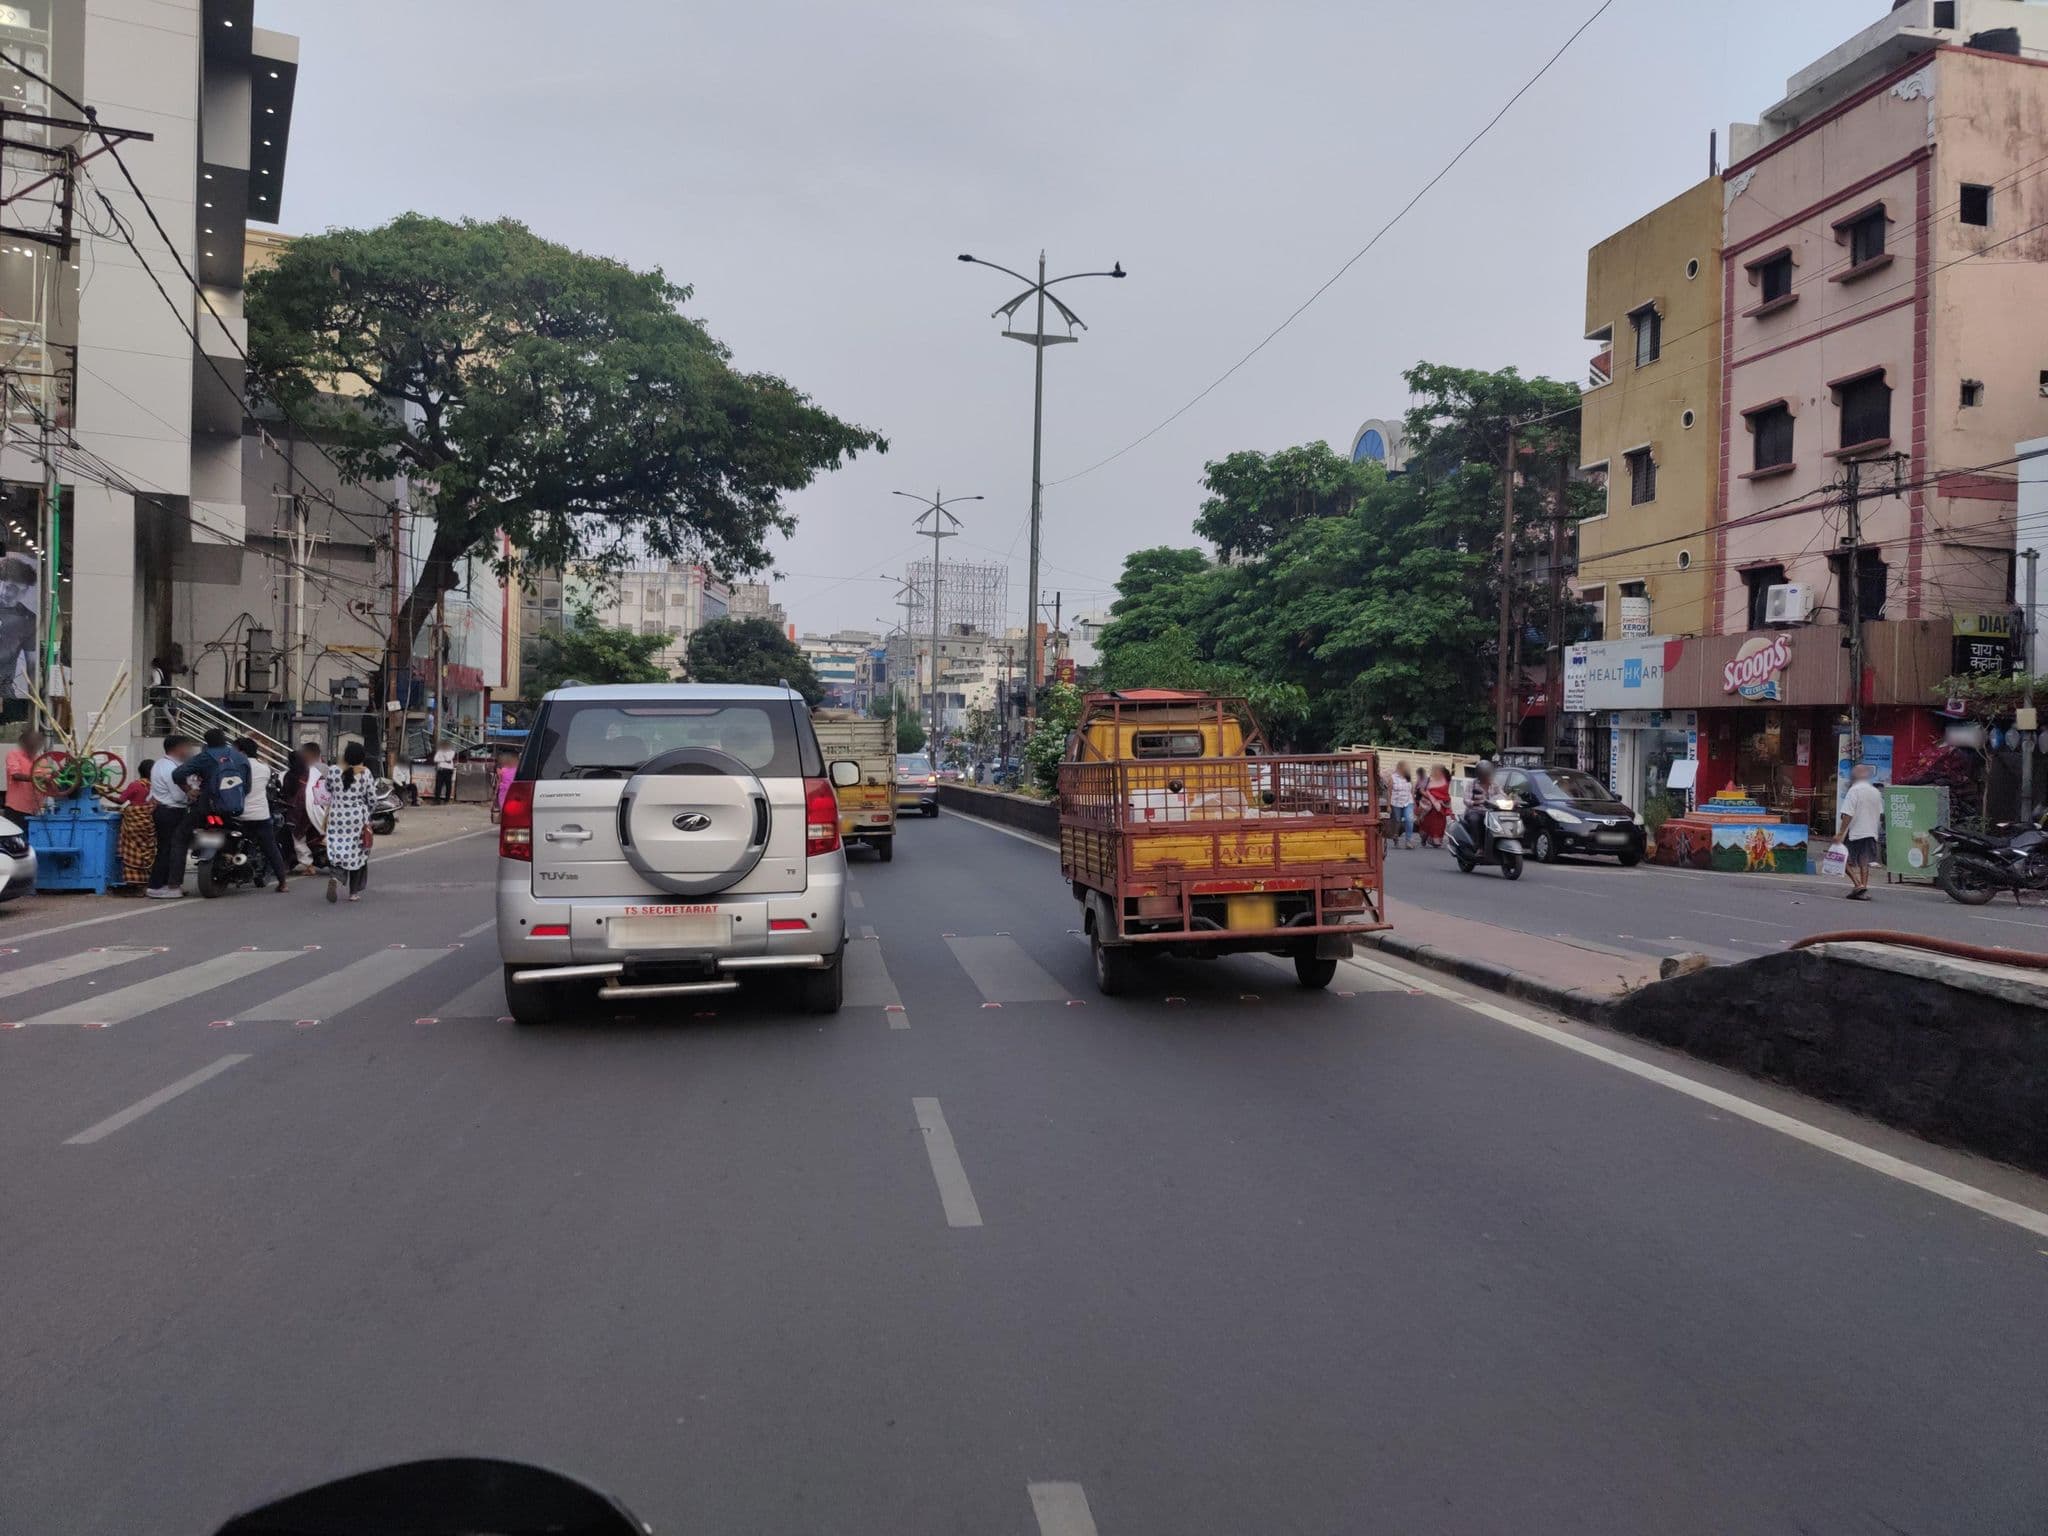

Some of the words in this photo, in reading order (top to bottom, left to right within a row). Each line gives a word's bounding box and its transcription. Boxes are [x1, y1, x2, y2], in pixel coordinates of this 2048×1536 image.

[1589, 665, 1664, 681] HEALTHKART
[624, 906, 638, 915] TS
[641, 905, 719, 915] SECRETARIAT
